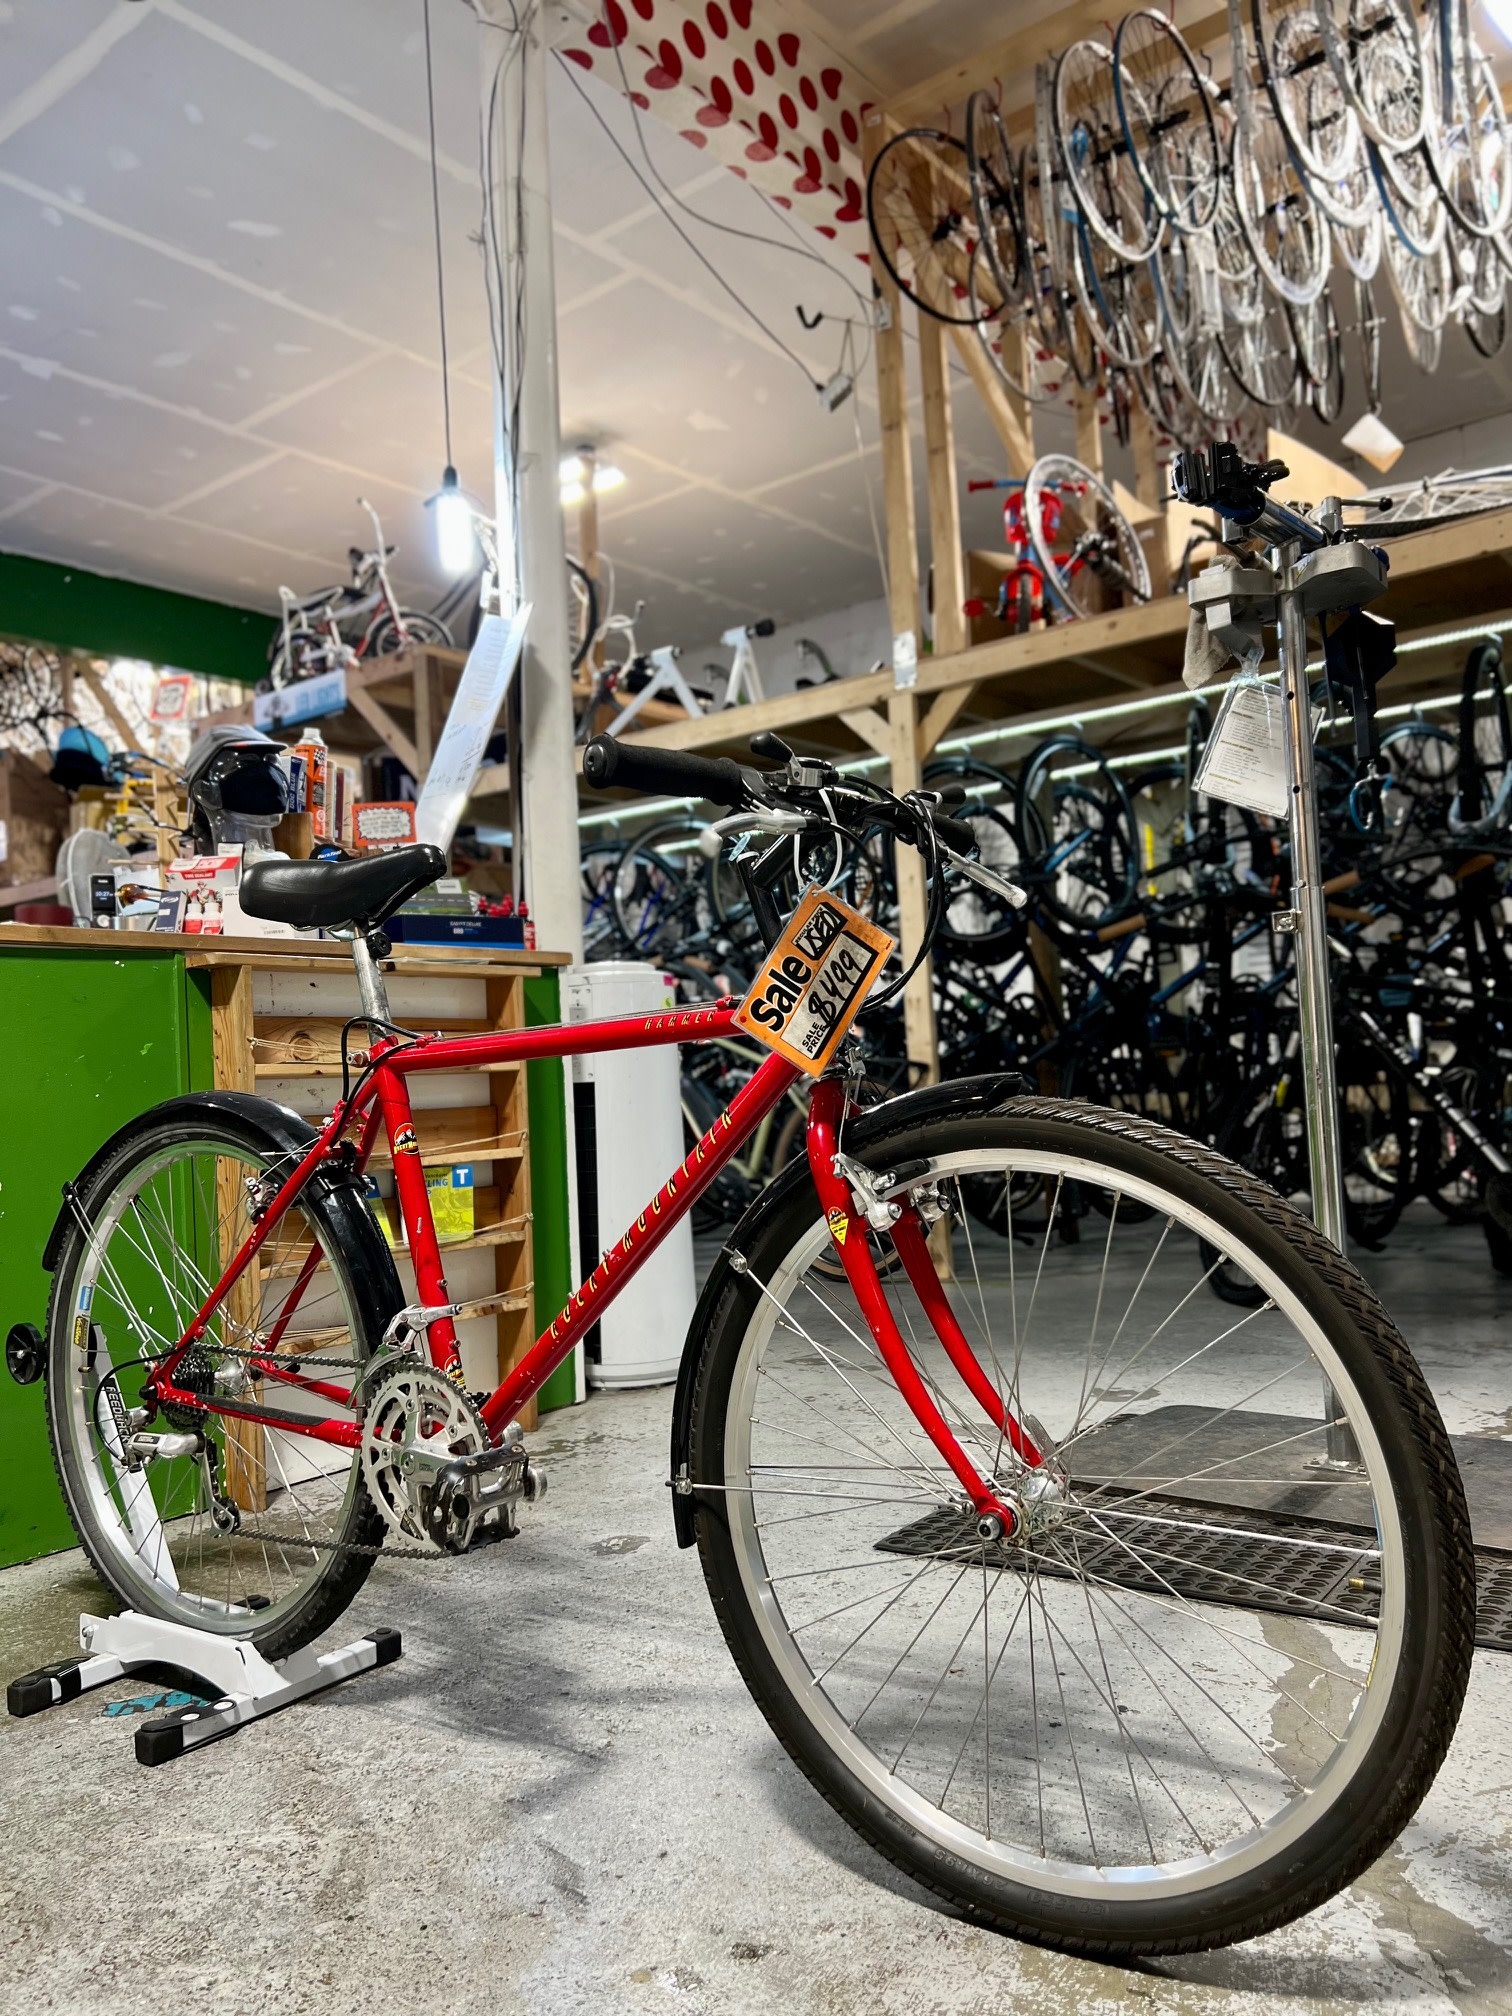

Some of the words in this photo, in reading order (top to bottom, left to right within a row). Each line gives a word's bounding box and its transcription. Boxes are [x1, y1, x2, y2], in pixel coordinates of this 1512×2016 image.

[750, 955, 812, 1033] Sale
[808, 948, 864, 1029] $499
[802, 1021, 820, 1048] SALE
[806, 1024, 827, 1054] PRICE
[456, 1168, 469, 1185] T
[550, 1258, 612, 1339] ROCKY
[621, 1107, 733, 1253] MOUNTAIN
